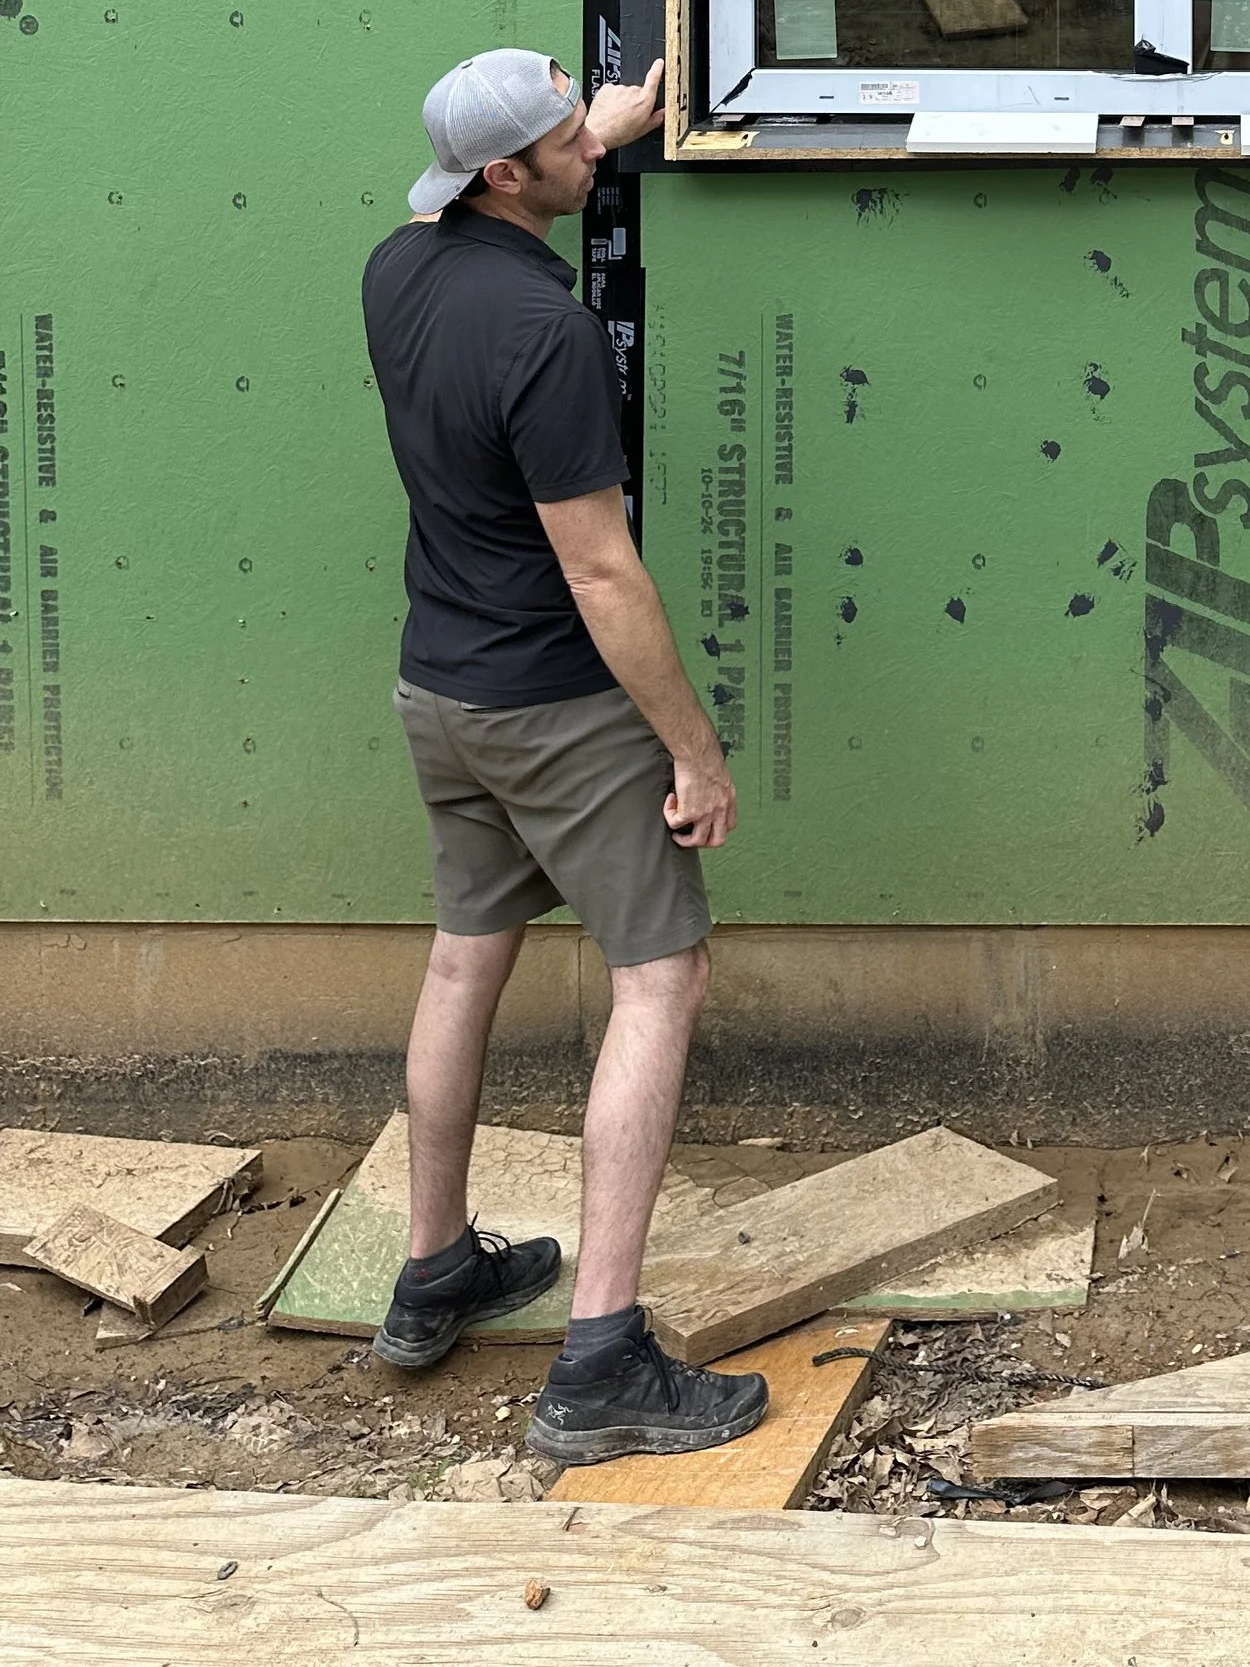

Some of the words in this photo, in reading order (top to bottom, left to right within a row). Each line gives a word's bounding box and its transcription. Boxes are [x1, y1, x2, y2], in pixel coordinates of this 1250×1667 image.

[34, 313, 56, 488] WATER-RESISTIVE
[717, 350, 746, 433] 7/16"
[775, 313, 793, 485] WATER-RESISTIVE
[39, 509, 56, 523] &
[775, 507, 793, 522] &
[40, 544, 58, 578] AIR
[774, 542, 793, 576] AIR
[40, 589, 59, 674] BARRIER
[774, 588, 792, 673] BARRIER
[773, 683, 792, 802] PROTECTION
